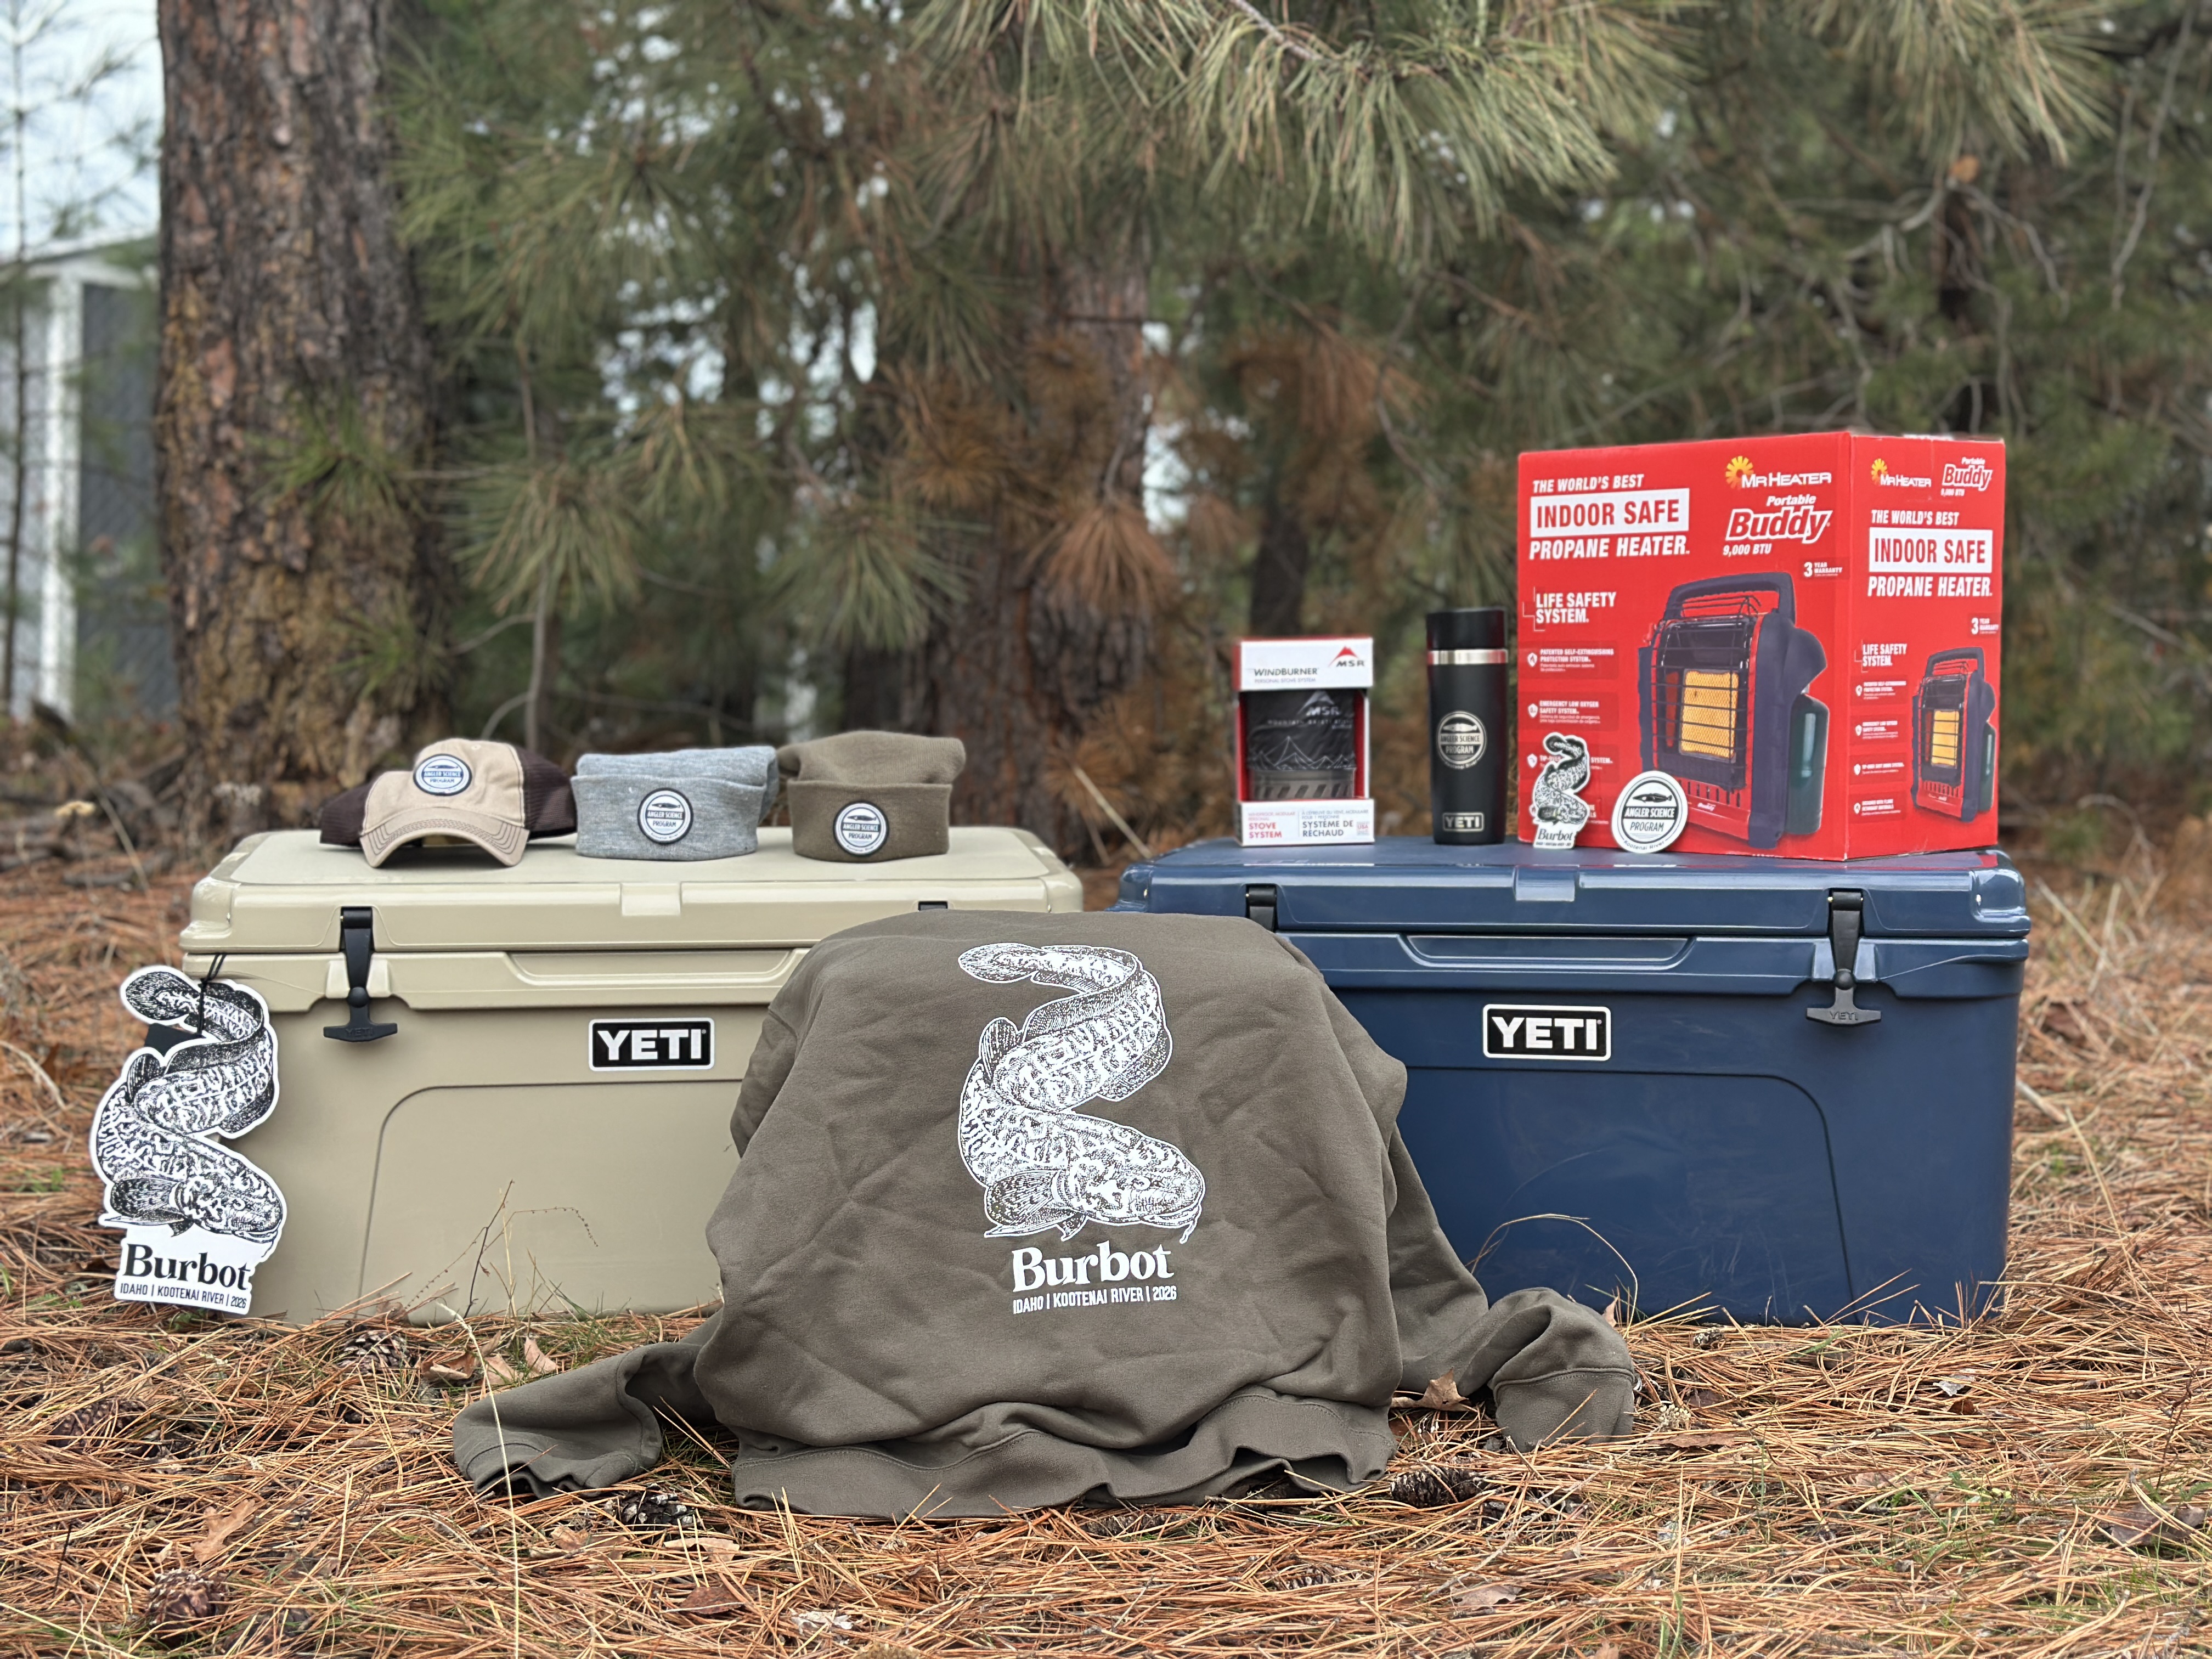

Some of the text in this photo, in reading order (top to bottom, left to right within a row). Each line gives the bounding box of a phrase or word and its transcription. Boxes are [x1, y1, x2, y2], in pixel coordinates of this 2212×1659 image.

[1533, 474, 1644, 493] THE WORLD'S BEST
[1942, 464, 1993, 491] Buddy
[1766, 494, 1816, 506] Portable
[1537, 499, 1679, 528] INDOOR SAFE
[1871, 510, 1959, 526] THE WORLD'S BEST
[1725, 505, 1833, 544] Buddy
[1529, 538, 1610, 560] PROPANE
[1723, 543, 1772, 557] 9,000 BTU
[1875, 538, 1985, 563] INDOOR SAFE
[1804, 562, 1813, 577] 3
[1867, 577, 1933, 596] PROPANE
[1536, 592, 1617, 607] LIFE SAFETY
[1536, 608, 1589, 623] SYSTEM.
[1971, 617, 1978, 634] 3
[1863, 644, 1907, 654] LIFE SAFETY
[1254, 668, 1318, 676] WINDBURNER
[1306, 706, 1340, 716] MSR
[1446, 746, 1474, 754] PROGRAM
[1624, 808, 1675, 818] ANGLER SCIENCE
[1445, 816, 1480, 828] YETI
[1630, 821, 1664, 832] PROGRAM
[1538, 828, 1573, 840] Burbot
[1624, 840, 1664, 850] Kootenai River
[1830, 1011, 1859, 1020] YETI
[1492, 1017, 1597, 1050] YETI
[597, 1029, 702, 1060] YETI
[122, 1244, 251, 1290] Burbot
[1012, 1240, 1175, 1292] Burbot
[120, 1283, 148, 1295] IDAHO
[157, 1286, 200, 1300] KOOTENAI
[202, 1291, 224, 1305] RIVER
[230, 1296, 247, 1308] 2026
[1013, 1296, 1043, 1314] IDAHO
[1053, 1289, 1107, 1307] KOOTENAI
[1111, 1286, 1143, 1303] RIVER
[1153, 1285, 1177, 1301] 2026
